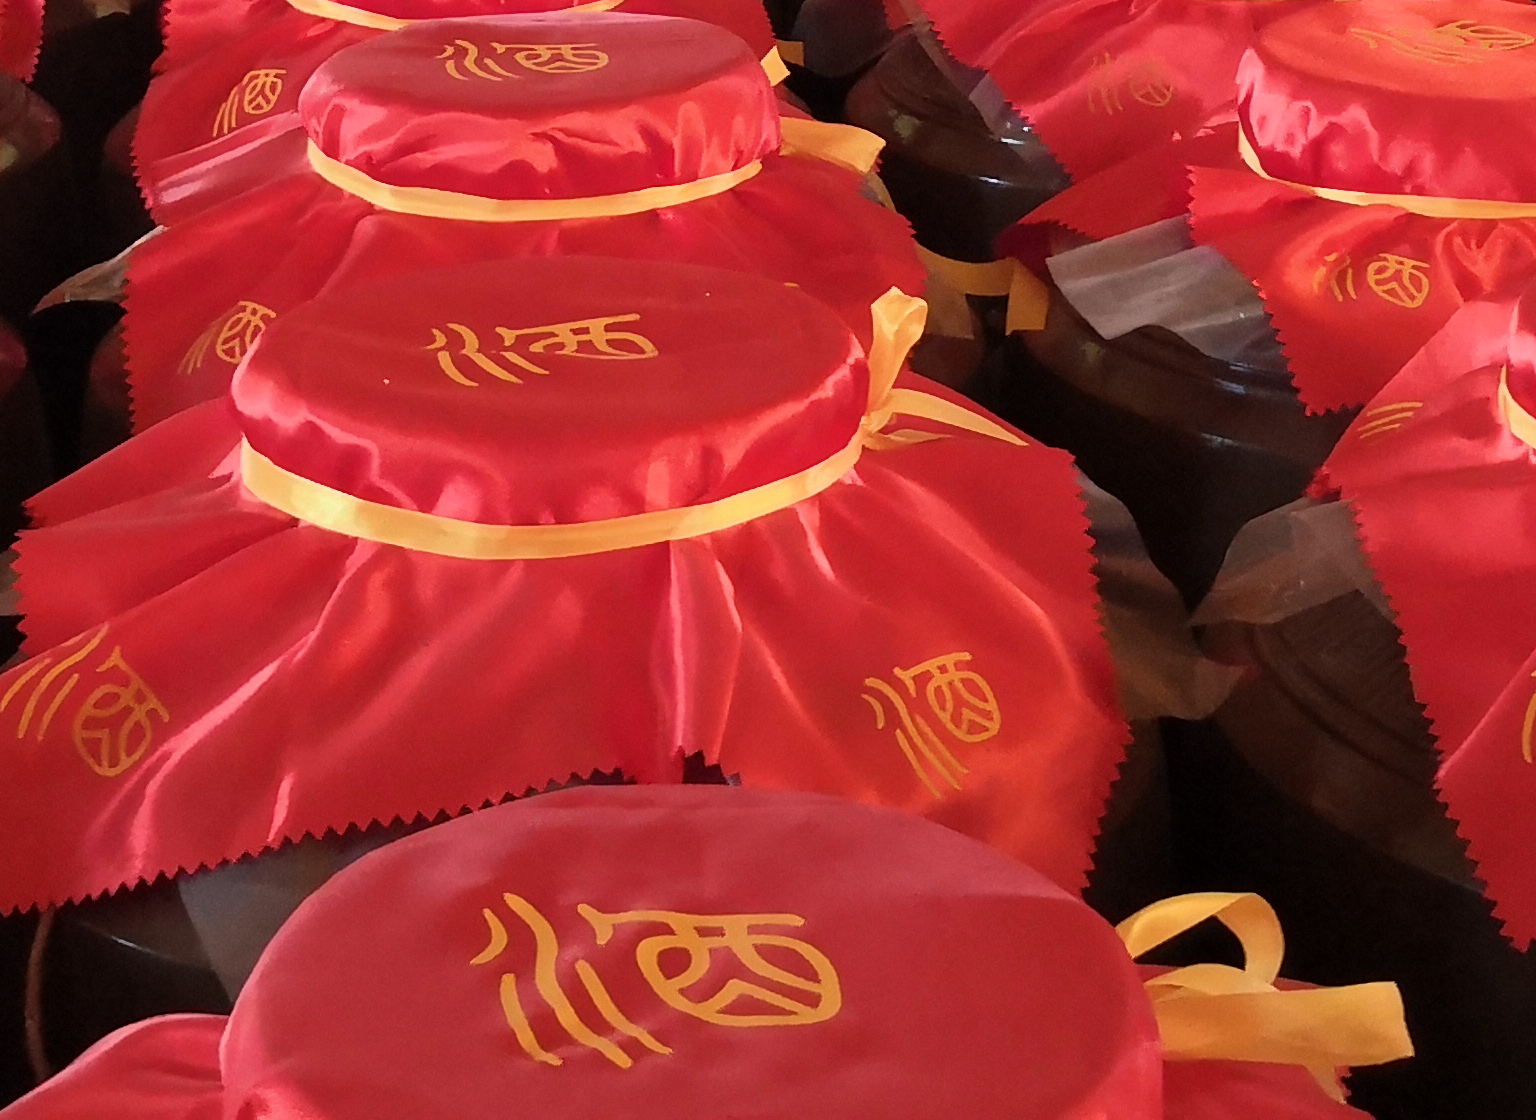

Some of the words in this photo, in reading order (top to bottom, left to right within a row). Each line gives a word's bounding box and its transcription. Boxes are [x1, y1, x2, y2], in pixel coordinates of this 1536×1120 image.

[436, 39, 610, 82] 酒
[1353, 18, 1536, 67] 酒
[425, 313, 659, 388] 酒
[0, 628, 170, 778] 酒
[864, 652, 1001, 798] 酒
[472, 894, 842, 1069] 酒
